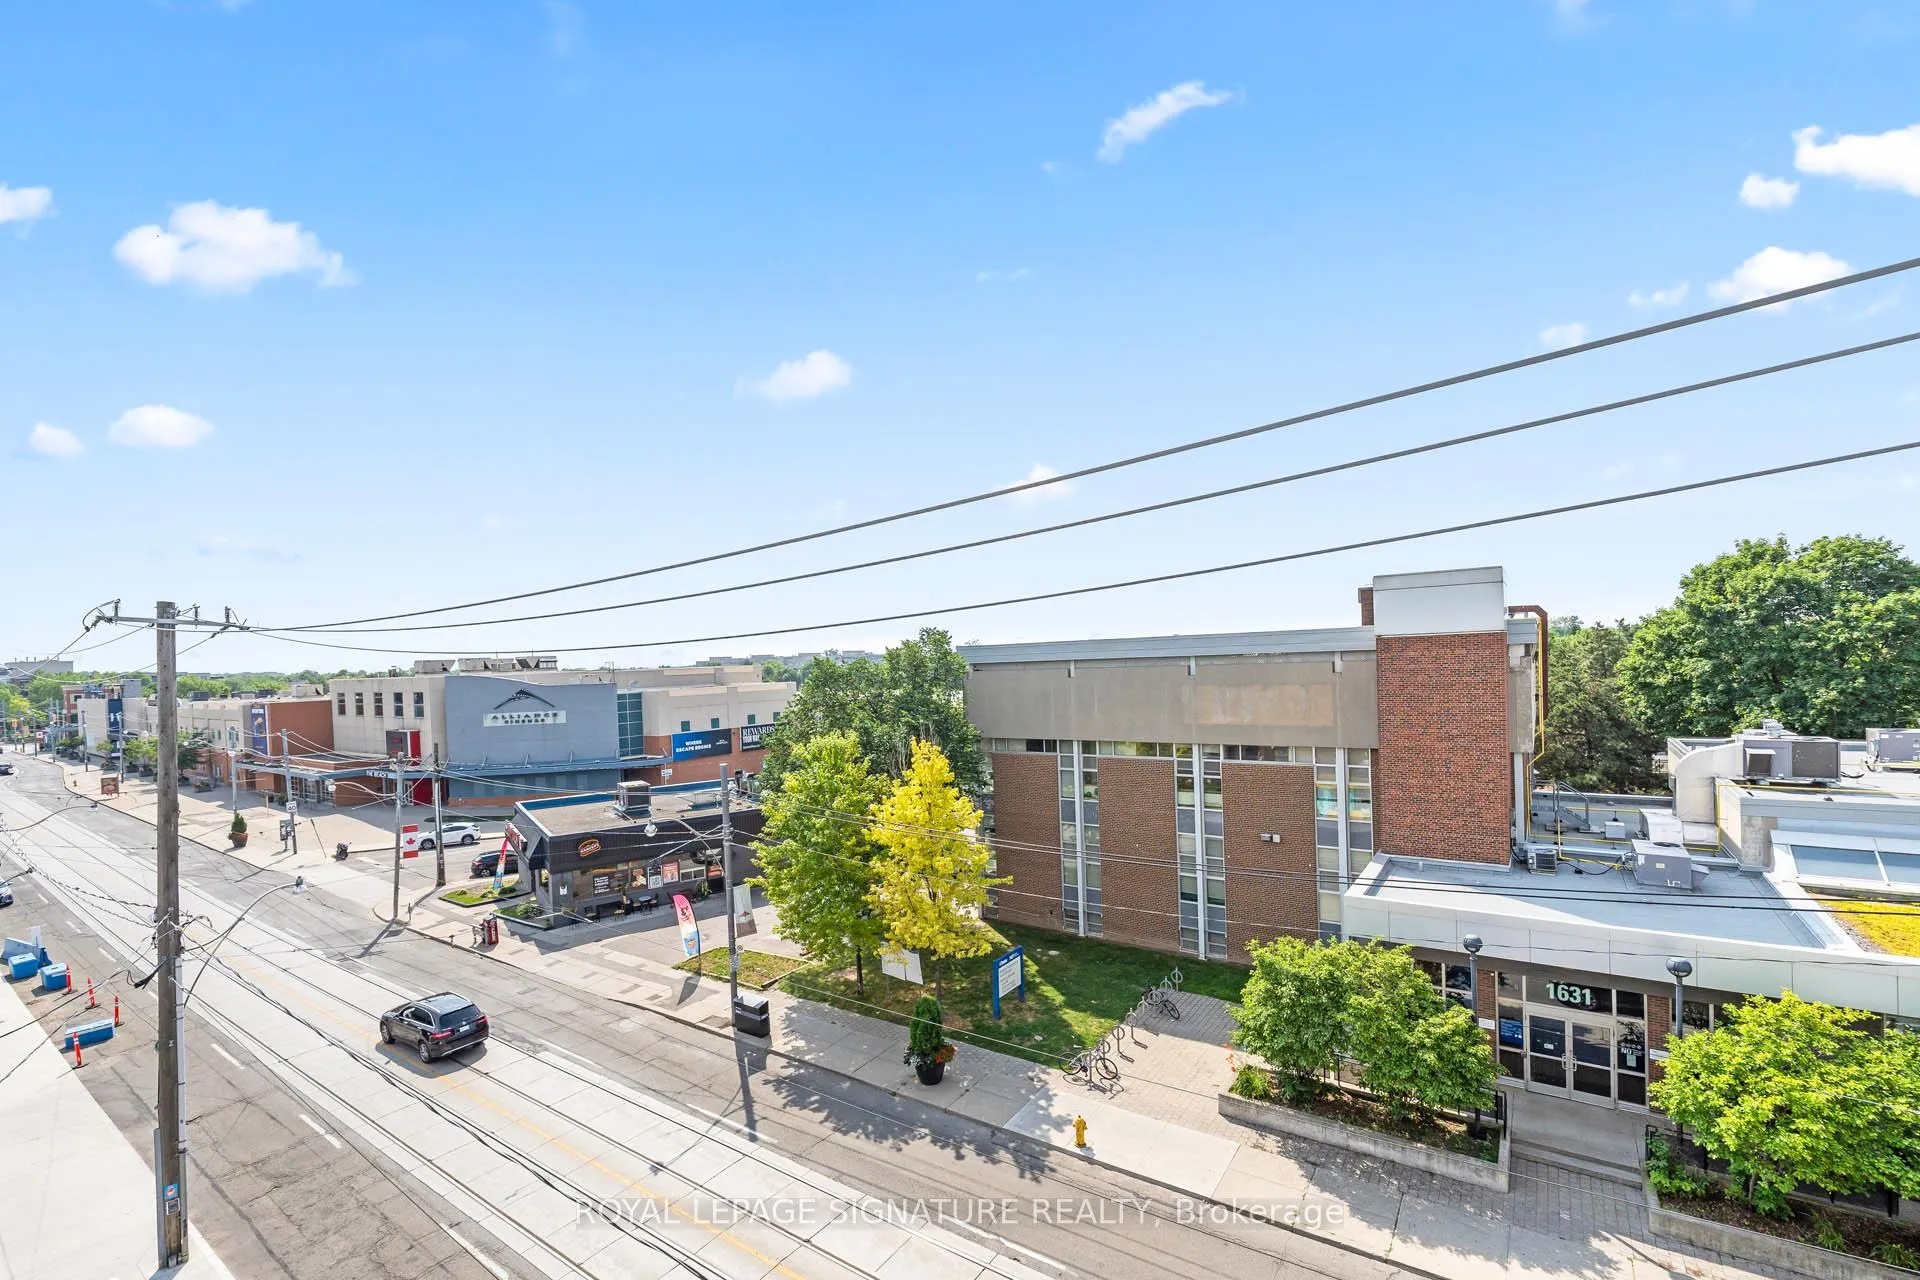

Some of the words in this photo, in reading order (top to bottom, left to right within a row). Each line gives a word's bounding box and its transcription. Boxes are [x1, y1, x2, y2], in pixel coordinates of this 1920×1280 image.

[742, 725, 776, 736] REWARDS
[675, 745, 694, 753] ESCAPE
[1546, 983, 1592, 1005] 1631
[1620, 1047, 1632, 1056] NO
